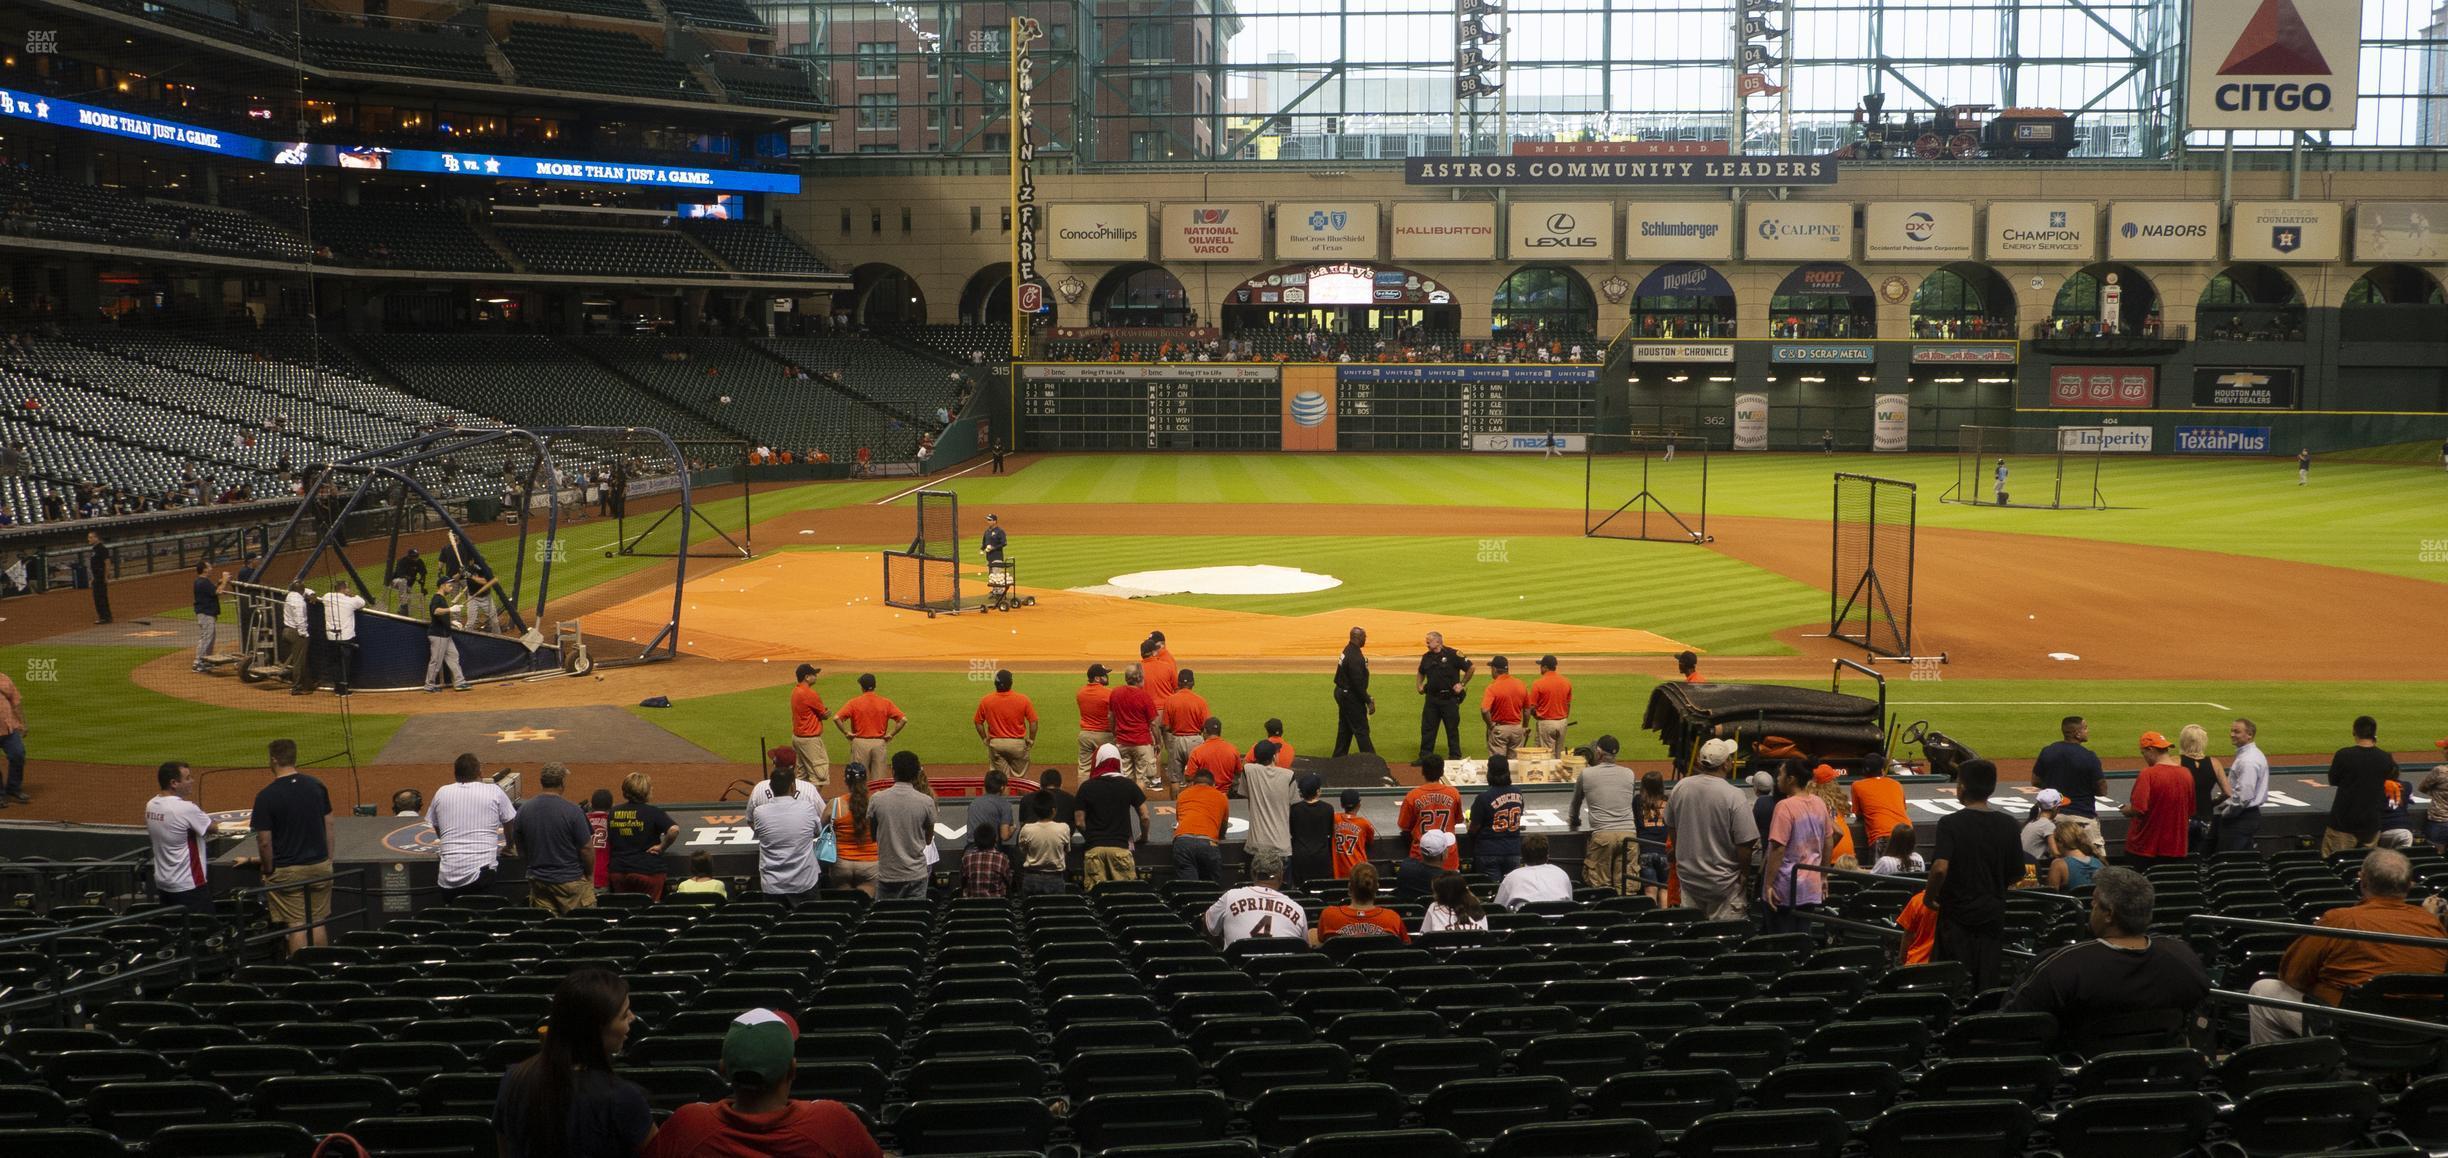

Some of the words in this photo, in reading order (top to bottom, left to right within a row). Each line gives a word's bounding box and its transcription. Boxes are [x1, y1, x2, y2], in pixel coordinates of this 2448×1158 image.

[1463, 25, 1476, 36] 86
[1746, 22, 1760, 33] 01
[1462, 52, 1475, 64] 97
[1746, 49, 1760, 62] 04
[1462, 79, 1476, 90] 98
[1745, 78, 1759, 90] 05
[2215, 83, 2331, 112] CITGO
[80, 109, 118, 130] MORE
[120, 117, 150, 136] THAN
[152, 123, 176, 140] JUST
[177, 129, 186, 142] A
[186, 130, 221, 148] GAME.
[1535, 145, 1626, 153] MINUTE
[1650, 145, 1708, 153] MAID
[464, 160, 480, 171] vs.
[536, 162, 582, 177] MORE
[585, 166, 624, 180] THAN
[626, 168, 656, 182] JUST
[657, 169, 667, 182] A
[668, 170, 714, 185] GAME.
[1530, 162, 1693, 178] COMMUNITY
[1705, 162, 1822, 177] LEADERS
[2256, 216, 2319, 224] FOUNDATION
[1184, 227, 1238, 235] NATIONAL
[1395, 226, 1492, 235] HALLIBURTON
[1641, 221, 1719, 239] Schlumberger
[1780, 224, 1841, 235] CALPINE
[1905, 223, 1934, 231] OXY
[2142, 224, 2208, 238] NABORS
[1060, 227, 1138, 242] ConocoPhillips
[1188, 236, 1234, 244] OILWELL
[2002, 229, 2080, 240] CHAMPION
[1525, 237, 1598, 248] LEXUS
[2002, 242, 2037, 250] ENERGY
[2039, 242, 2079, 250] SERVICES
[1194, 245, 1230, 254] VARCO
[1310, 263, 1374, 280] Landry's
[1804, 272, 1845, 282] ROOT
[1664, 268, 1707, 290] Montejo
[2031, 278, 2044, 287] DK
[1638, 347, 1676, 356] HOUSTON
[1684, 347, 1728, 356] CHRONICLE
[1779, 349, 1786, 358] C
[1788, 350, 1794, 358] &
[1798, 350, 1806, 358] D
[1810, 350, 1838, 358] SCRAP
[1840, 350, 1868, 358] METAL
[992, 366, 1010, 375] 315
[1051, 368, 1066, 376] bmc
[1148, 368, 1162, 376] bmc
[2062, 385, 2078, 394] 66
[2093, 385, 2110, 394] 66
[2124, 386, 2142, 395] 66
[1704, 416, 1726, 424] 362
[1512, 438, 1566, 448] maza
[2080, 432, 2150, 448] Insperity
[2180, 431, 2264, 450] TexanPlus
[146, 812, 164, 822] WELCH
[1420, 808, 1450, 832] 27
[1492, 806, 1521, 832] 60
[1335, 832, 1358, 856] 27
[1230, 899, 1300, 926] SPRINGER
[1250, 914, 1272, 938] 4
